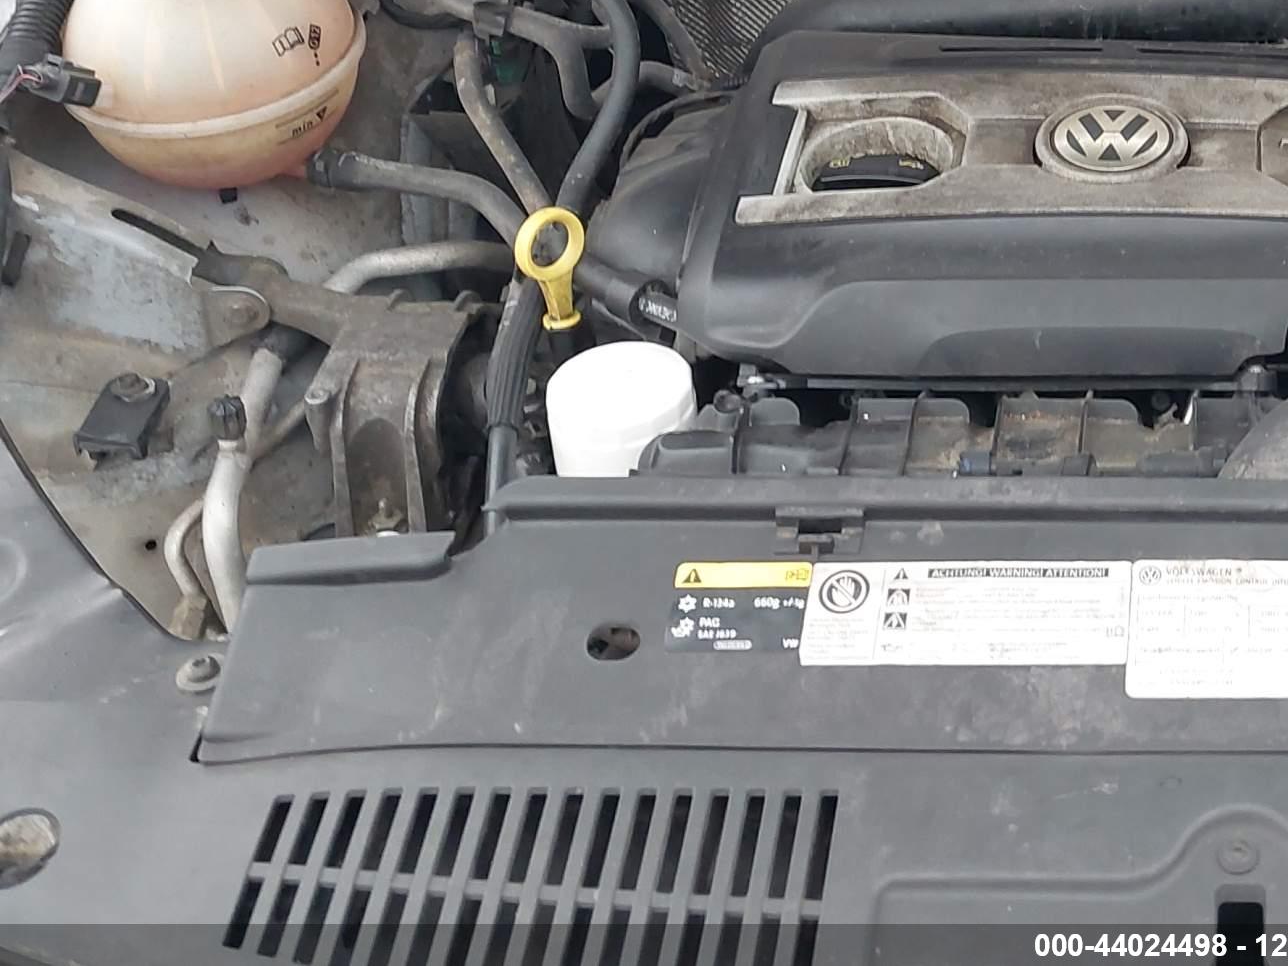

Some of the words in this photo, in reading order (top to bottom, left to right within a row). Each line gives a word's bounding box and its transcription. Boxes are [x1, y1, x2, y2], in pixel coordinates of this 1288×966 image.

[292, 120, 313, 138] min
[987, 568, 1042, 578] WARNING!
[1044, 568, 1107, 578] ATTENTION!
